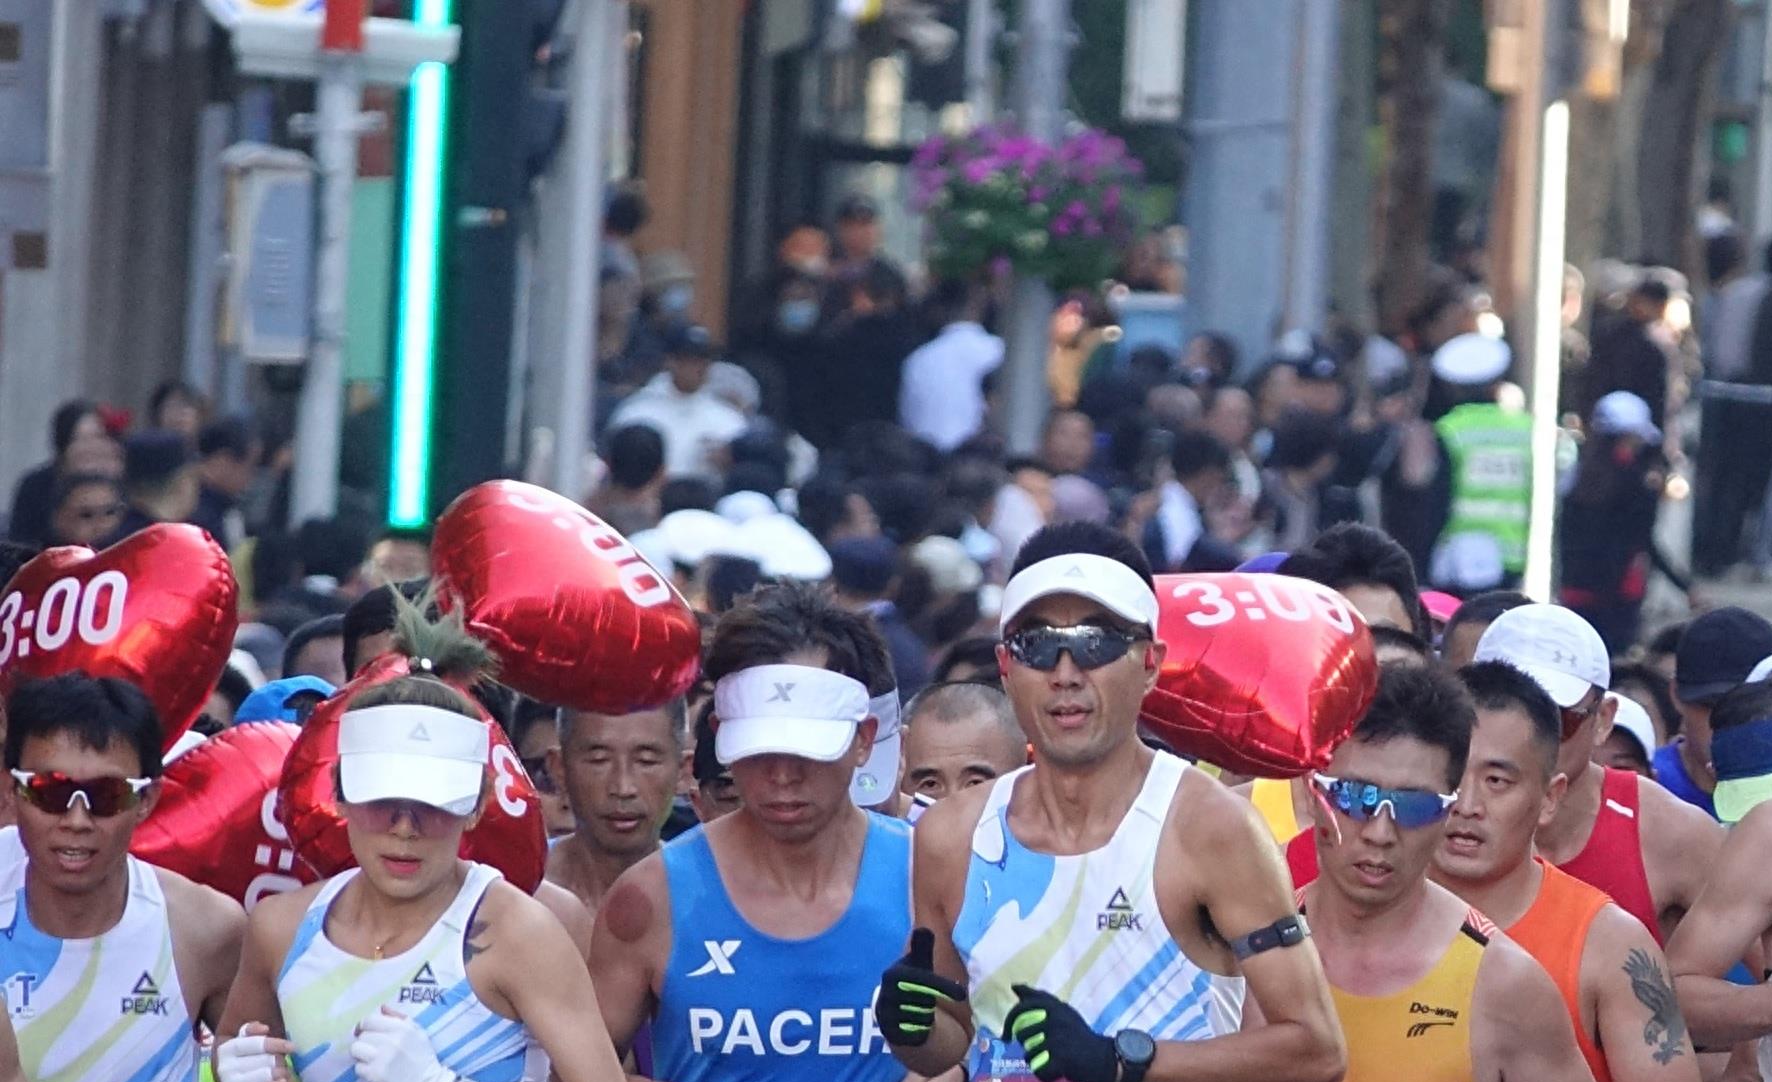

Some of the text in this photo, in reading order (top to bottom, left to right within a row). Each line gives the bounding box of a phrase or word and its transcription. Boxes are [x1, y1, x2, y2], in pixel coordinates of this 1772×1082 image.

[1096, 912, 1143, 931] PEAK
[399, 986, 446, 1005] PEAK
[120, 997, 168, 1016] PEAK
